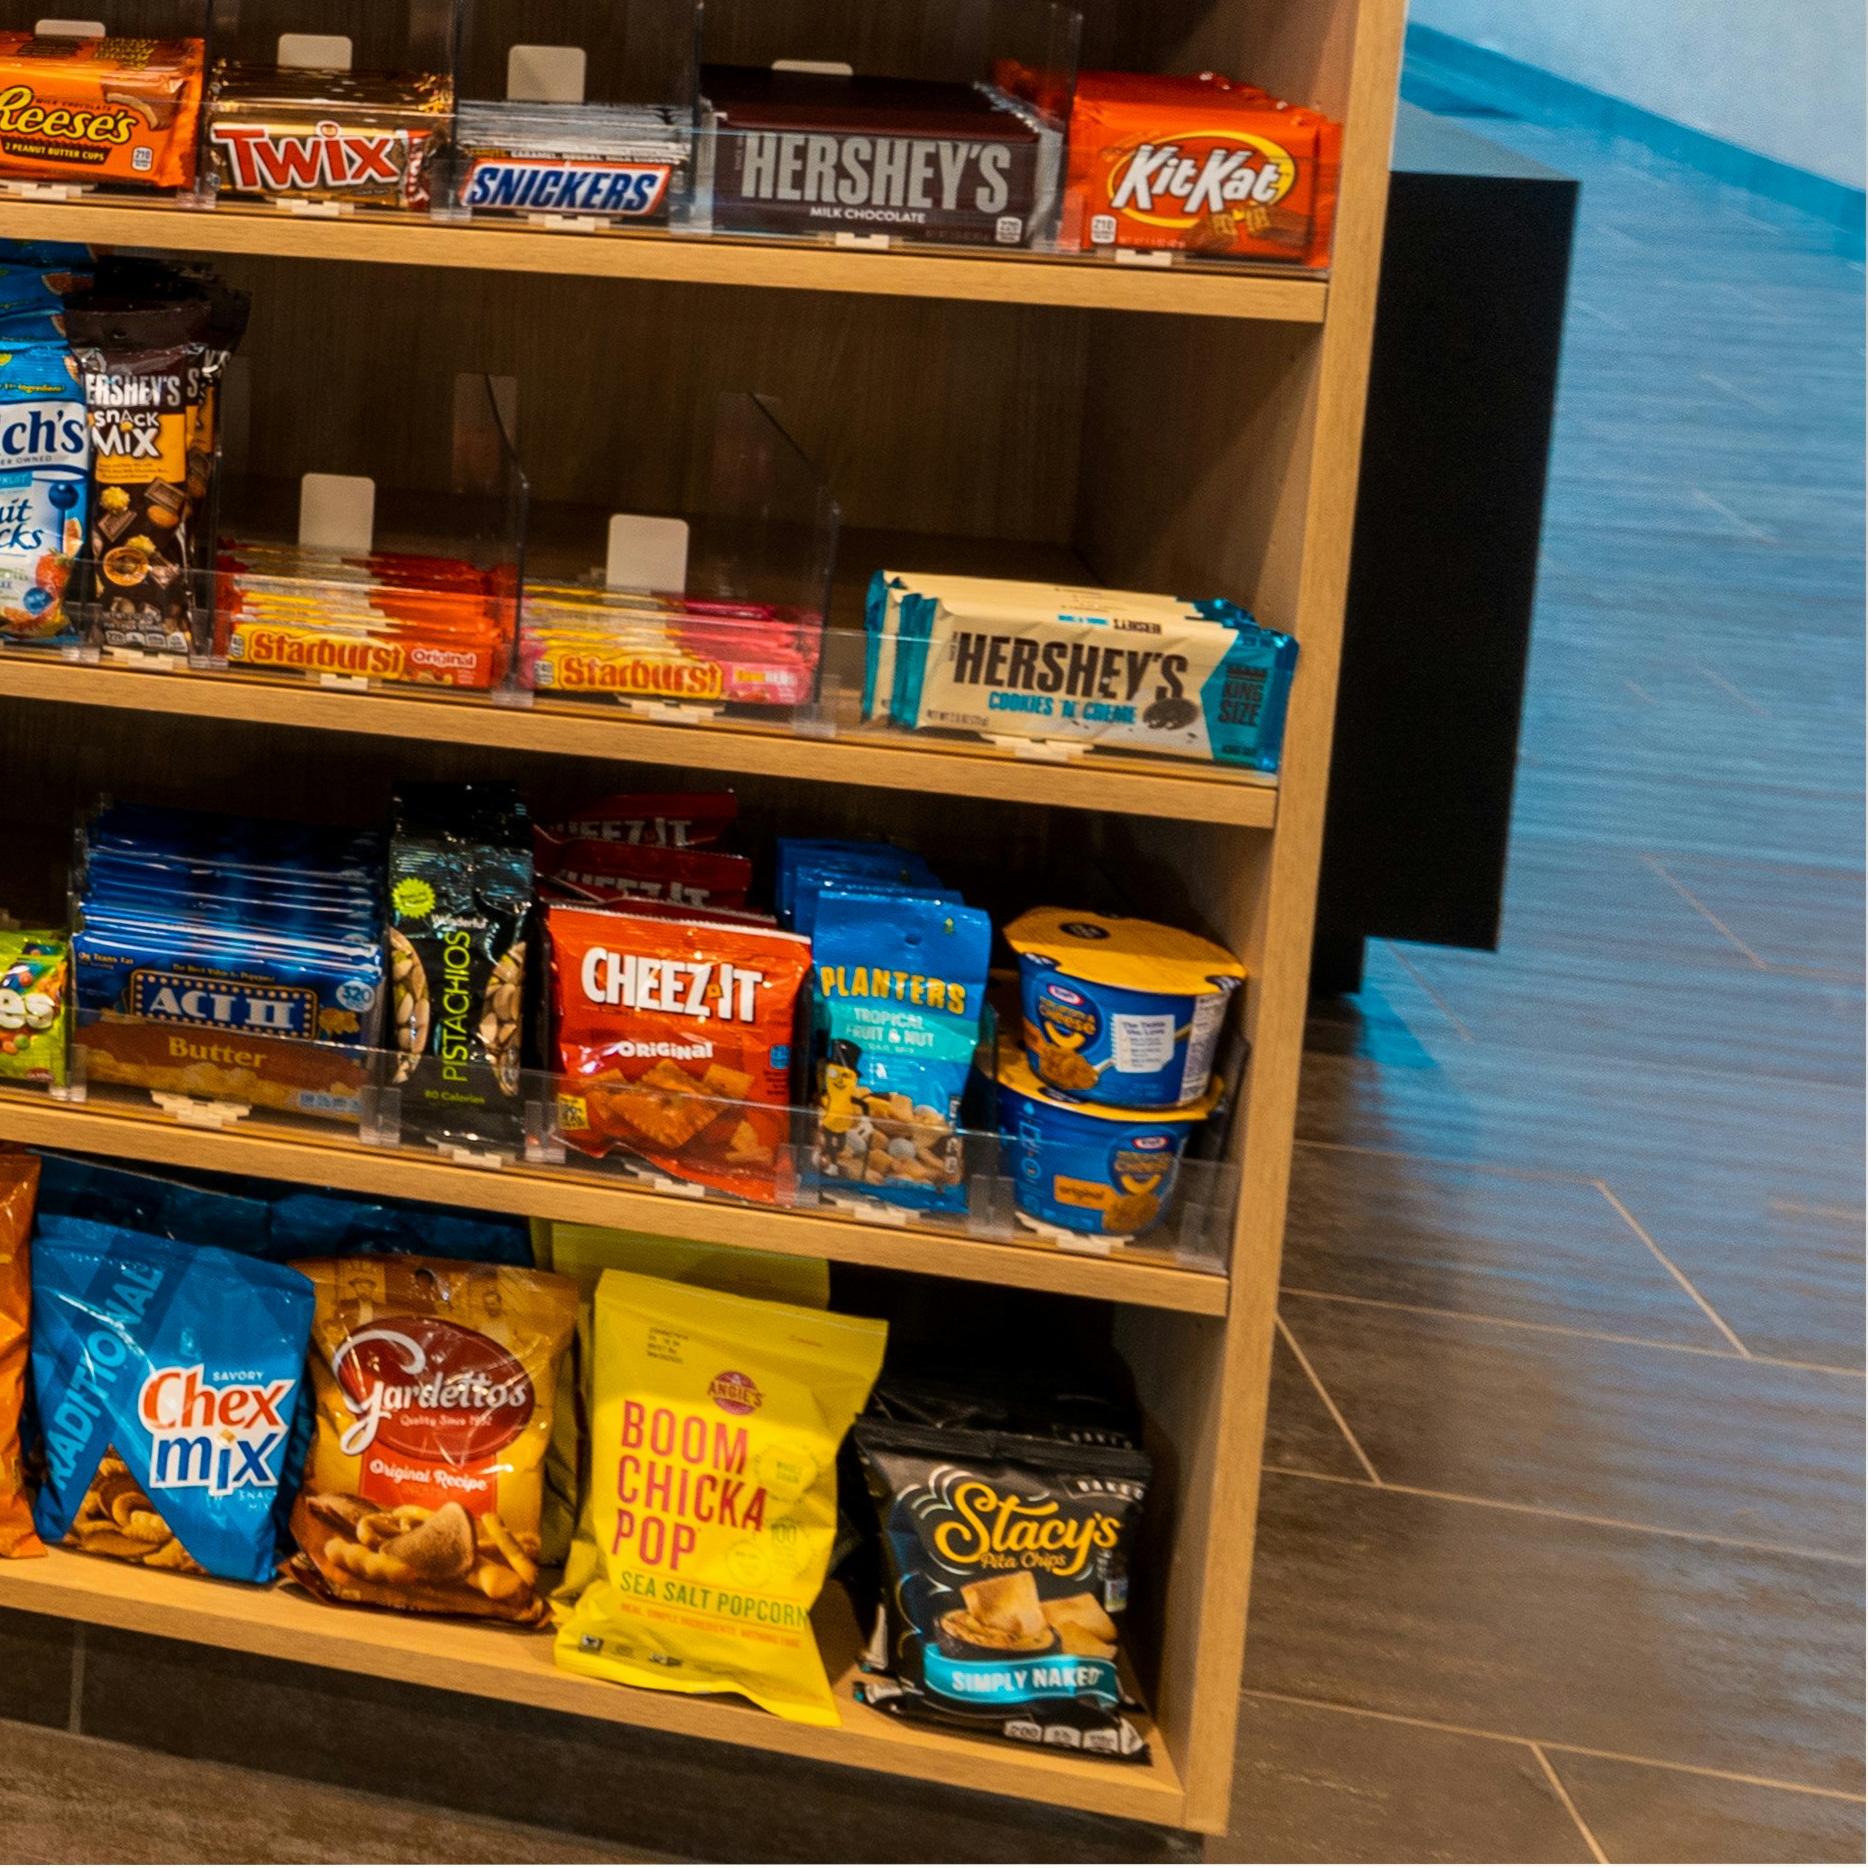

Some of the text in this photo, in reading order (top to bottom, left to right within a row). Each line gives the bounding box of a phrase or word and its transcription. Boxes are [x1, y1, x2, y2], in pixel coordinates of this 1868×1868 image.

[5, 142, 104, 161] 2 PEANUT BUTTER CUPS
[212, 121, 400, 190] TWIX
[467, 167, 658, 211] SNICKERS
[742, 132, 1011, 213] HERSHEY'S
[811, 207, 926, 223] MILK CHOCOLATE
[86, 374, 181, 406] ERSHEY'S
[252, 634, 404, 673] Starburst
[954, 632, 1188, 701] HERSHEY'S
[563, 657, 721, 693] Starburst
[989, 692, 1054, 717] COOKIES
[1220, 701, 1260, 725] SIZE
[149, 988, 236, 1022] ACT
[443, 931, 471, 1082] PISTACHIOS
[820, 966, 965, 1014] PLANTERS
[168, 1036, 267, 1068] Butter
[51, 1268, 164, 1490] RADITIONAL
[213, 1371, 263, 1381] SAVORY
[707, 1381, 763, 1408] ANGIE'S
[143, 1371, 285, 1429] Chex
[621, 1401, 747, 1475] BOOM
[156, 1432, 279, 1489] mix
[370, 1459, 487, 1491] Original Recipe
[618, 1455, 767, 1532] CHICKA
[612, 1509, 696, 1570] POP
[935, 1482, 1121, 1575] Stacy's
[979, 1552, 1066, 1570] Pita Chips
[620, 1571, 807, 1626] SEA SALT POPCORN
[952, 1666, 1100, 1693] SIMPLY NAKED
